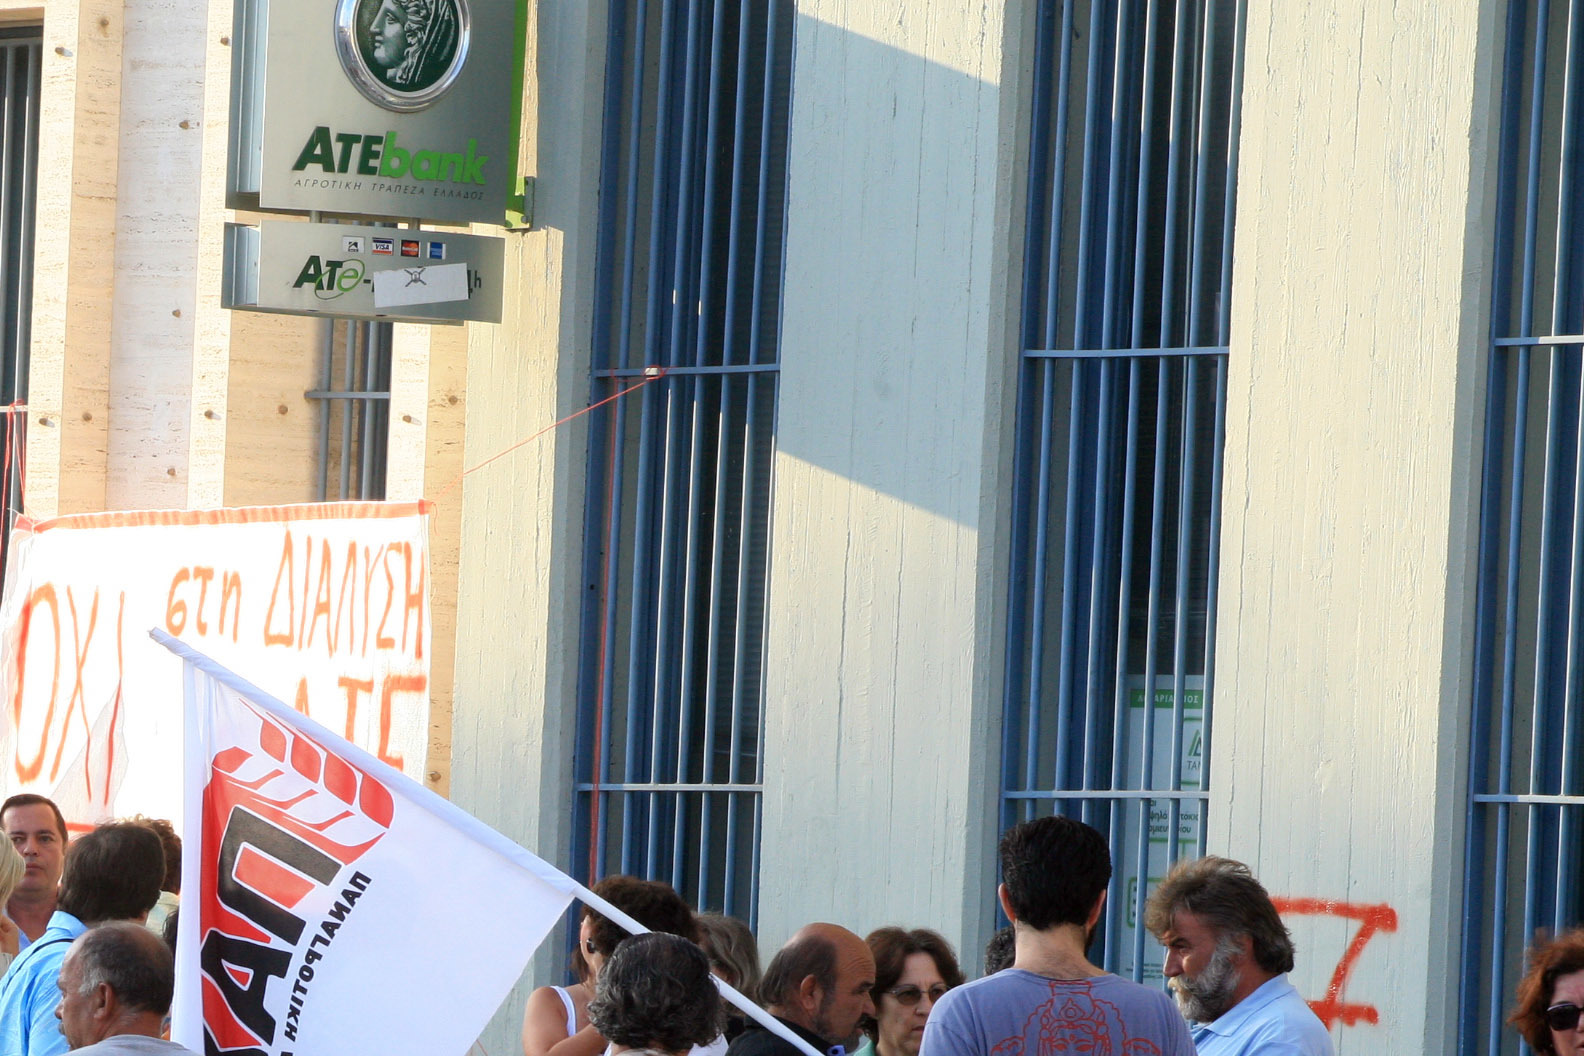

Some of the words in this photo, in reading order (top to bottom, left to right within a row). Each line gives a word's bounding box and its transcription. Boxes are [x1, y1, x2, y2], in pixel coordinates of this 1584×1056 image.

[292, 126, 490, 185] ATEbank
[294, 179, 362, 190] ΑΓΡΟΤΙΚΗ
[371, 183, 425, 195] ΤΡΑΠΕΖΑ
[434, 187, 484, 200] ΕΛΛΑΔΟΣ
[374, 243, 391, 251] VISA
[263, 529, 425, 659] ΔΙΑΛΥΣΗ
[16, 582, 125, 808] ΟΧΙ
